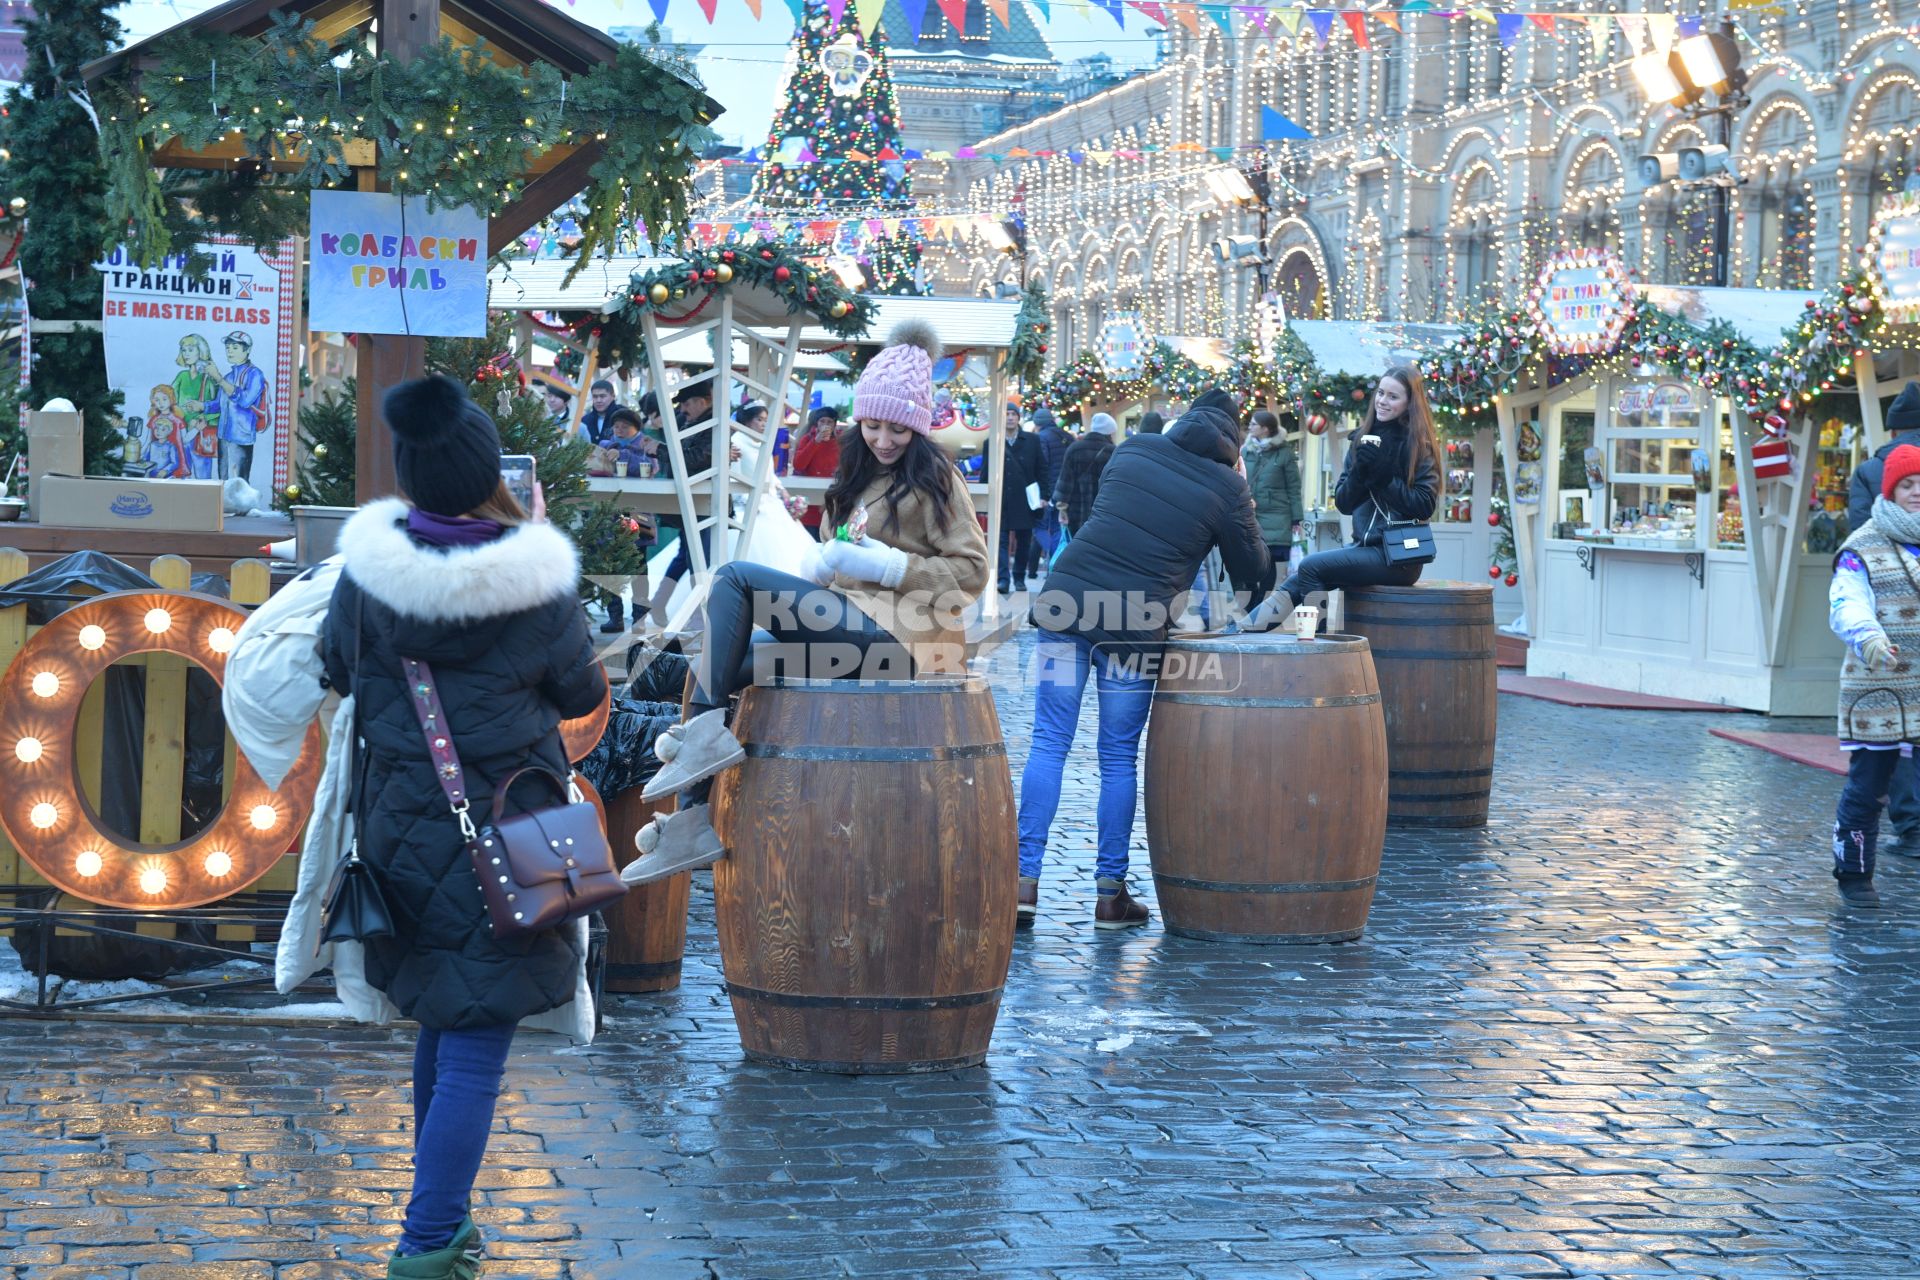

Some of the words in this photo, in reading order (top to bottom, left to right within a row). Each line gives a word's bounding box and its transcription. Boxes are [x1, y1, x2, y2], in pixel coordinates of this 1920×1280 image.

[320, 232, 478, 262] КОЛБАСКИ
[351, 265, 447, 291] ГРИЛЬ
[132, 302, 207, 321] MASTER
[212, 306, 271, 325] CLASS
